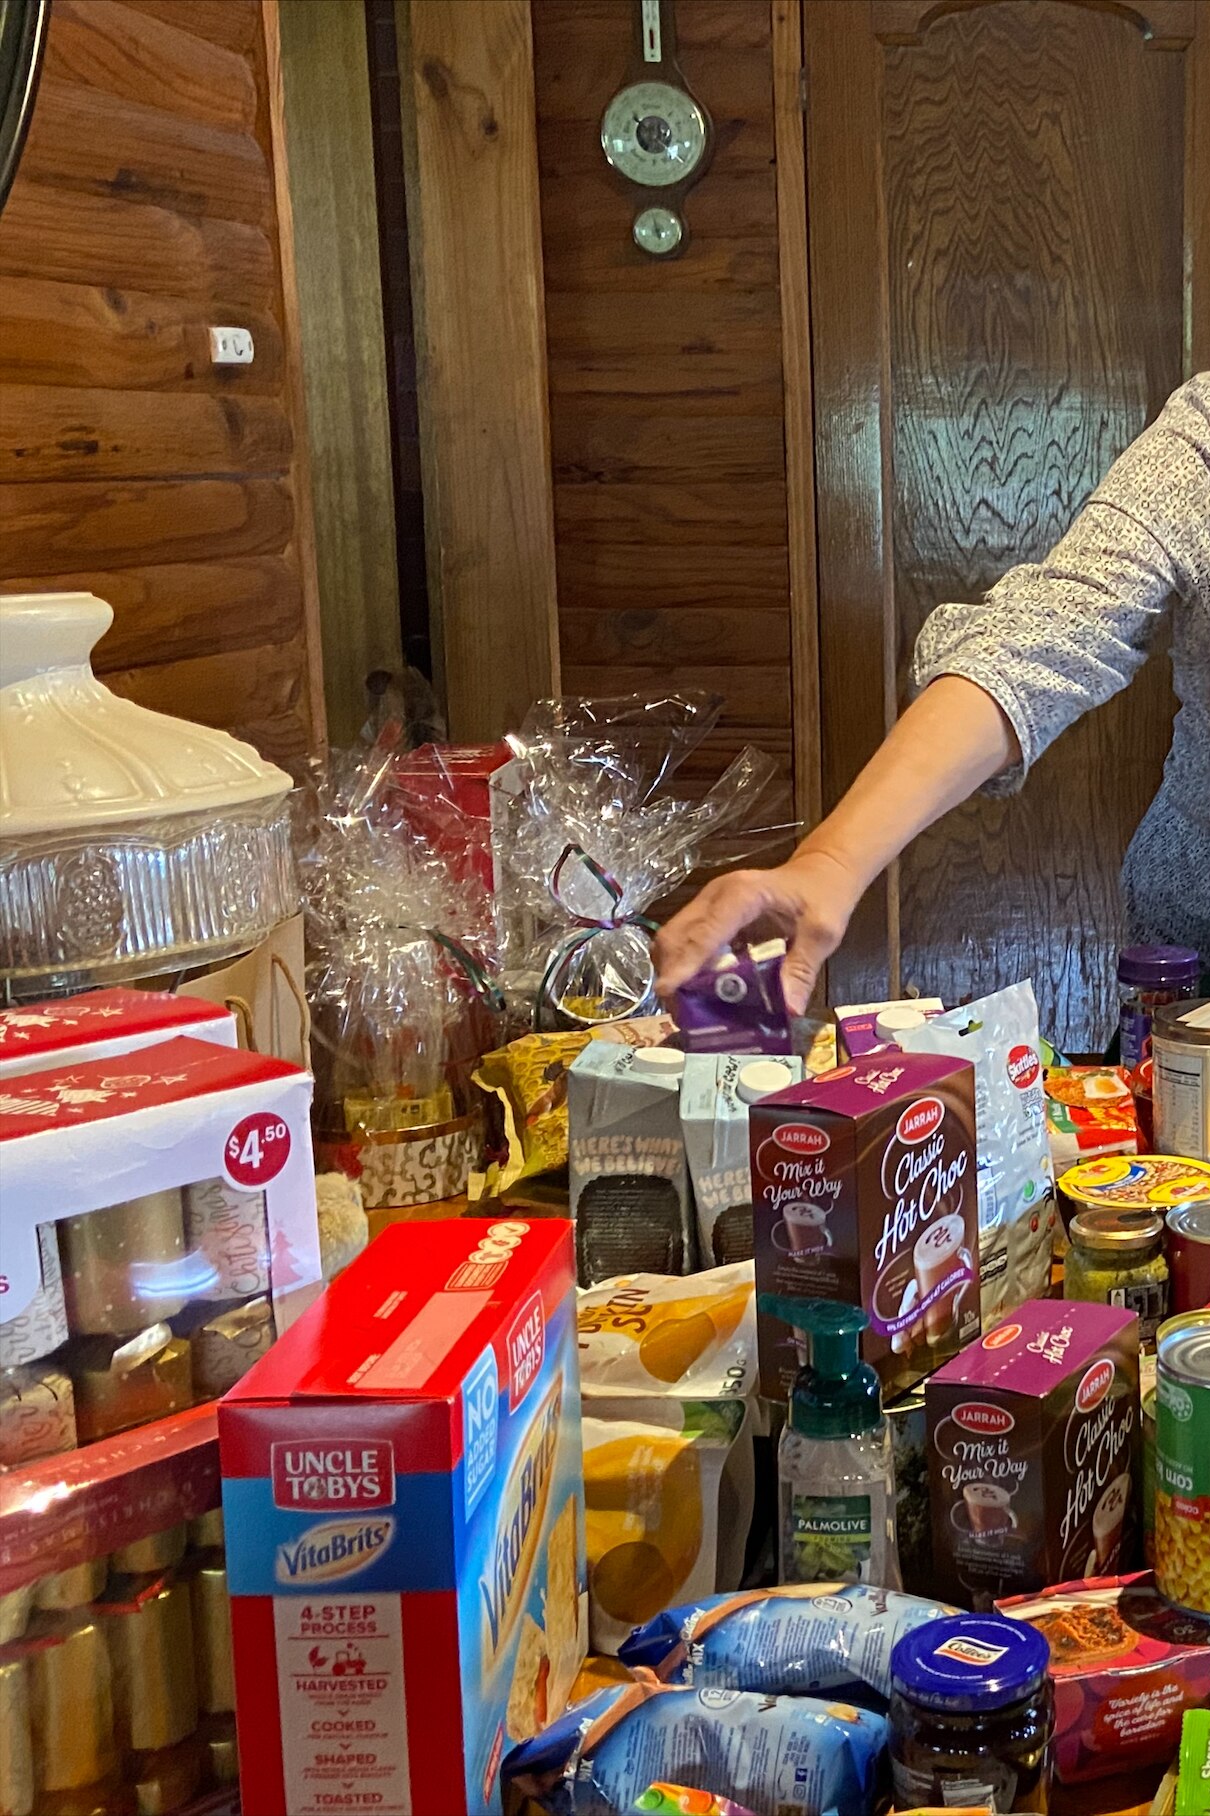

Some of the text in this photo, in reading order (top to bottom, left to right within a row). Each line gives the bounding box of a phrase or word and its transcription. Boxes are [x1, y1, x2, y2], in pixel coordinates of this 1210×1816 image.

[903, 1107, 938, 1135] JARRAH
[228, 1122, 287, 1169] $4.50
[780, 1133, 823, 1146] JARRAH
[773, 1158, 825, 1181] Mix it
[894, 1132, 945, 1196] Classic
[763, 1184, 802, 1211] Your
[801, 1177, 843, 1200] Way
[874, 1197, 918, 1272] Hot
[919, 1149, 968, 1222] Choc
[512, 1304, 541, 1367] UNCLE
[514, 1336, 543, 1397] TOBYS
[1080, 1371, 1111, 1404] JARRAH
[467, 1374, 496, 1444] NO
[959, 1410, 1008, 1426] JARRAH
[467, 1417, 496, 1466] ADDED
[1075, 1397, 1116, 1467] Classic
[284, 1449, 379, 1475] UNCLE
[953, 1438, 1010, 1462] Mix it
[467, 1441, 495, 1492] SUGAR
[941, 1457, 1029, 1491] Your Way
[1060, 1405, 1134, 1550] Hot Choc
[1165, 1467, 1193, 1491] corn
[285, 1475, 382, 1500] TOBYS
[797, 1519, 868, 1532] PALMOLIVE
[282, 1523, 386, 1577] VitaBrits
[300, 1605, 377, 1621] 4-STEP
[301, 1621, 378, 1635] PROCESS
[295, 1678, 388, 1692] HARVESTED
[1108, 1692, 1150, 1710] Variety
[1160, 1683, 1179, 1695] the
[1103, 1707, 1131, 1725] spice
[1143, 1697, 1161, 1712] life
[1162, 1690, 1184, 1705] and
[311, 1720, 377, 1732] COOKED
[1113, 1718, 1129, 1730] the
[1119, 1719, 1167, 1738] boredom
[314, 1753, 378, 1766] SHAPED
[313, 1792, 384, 1805] TOASTED
